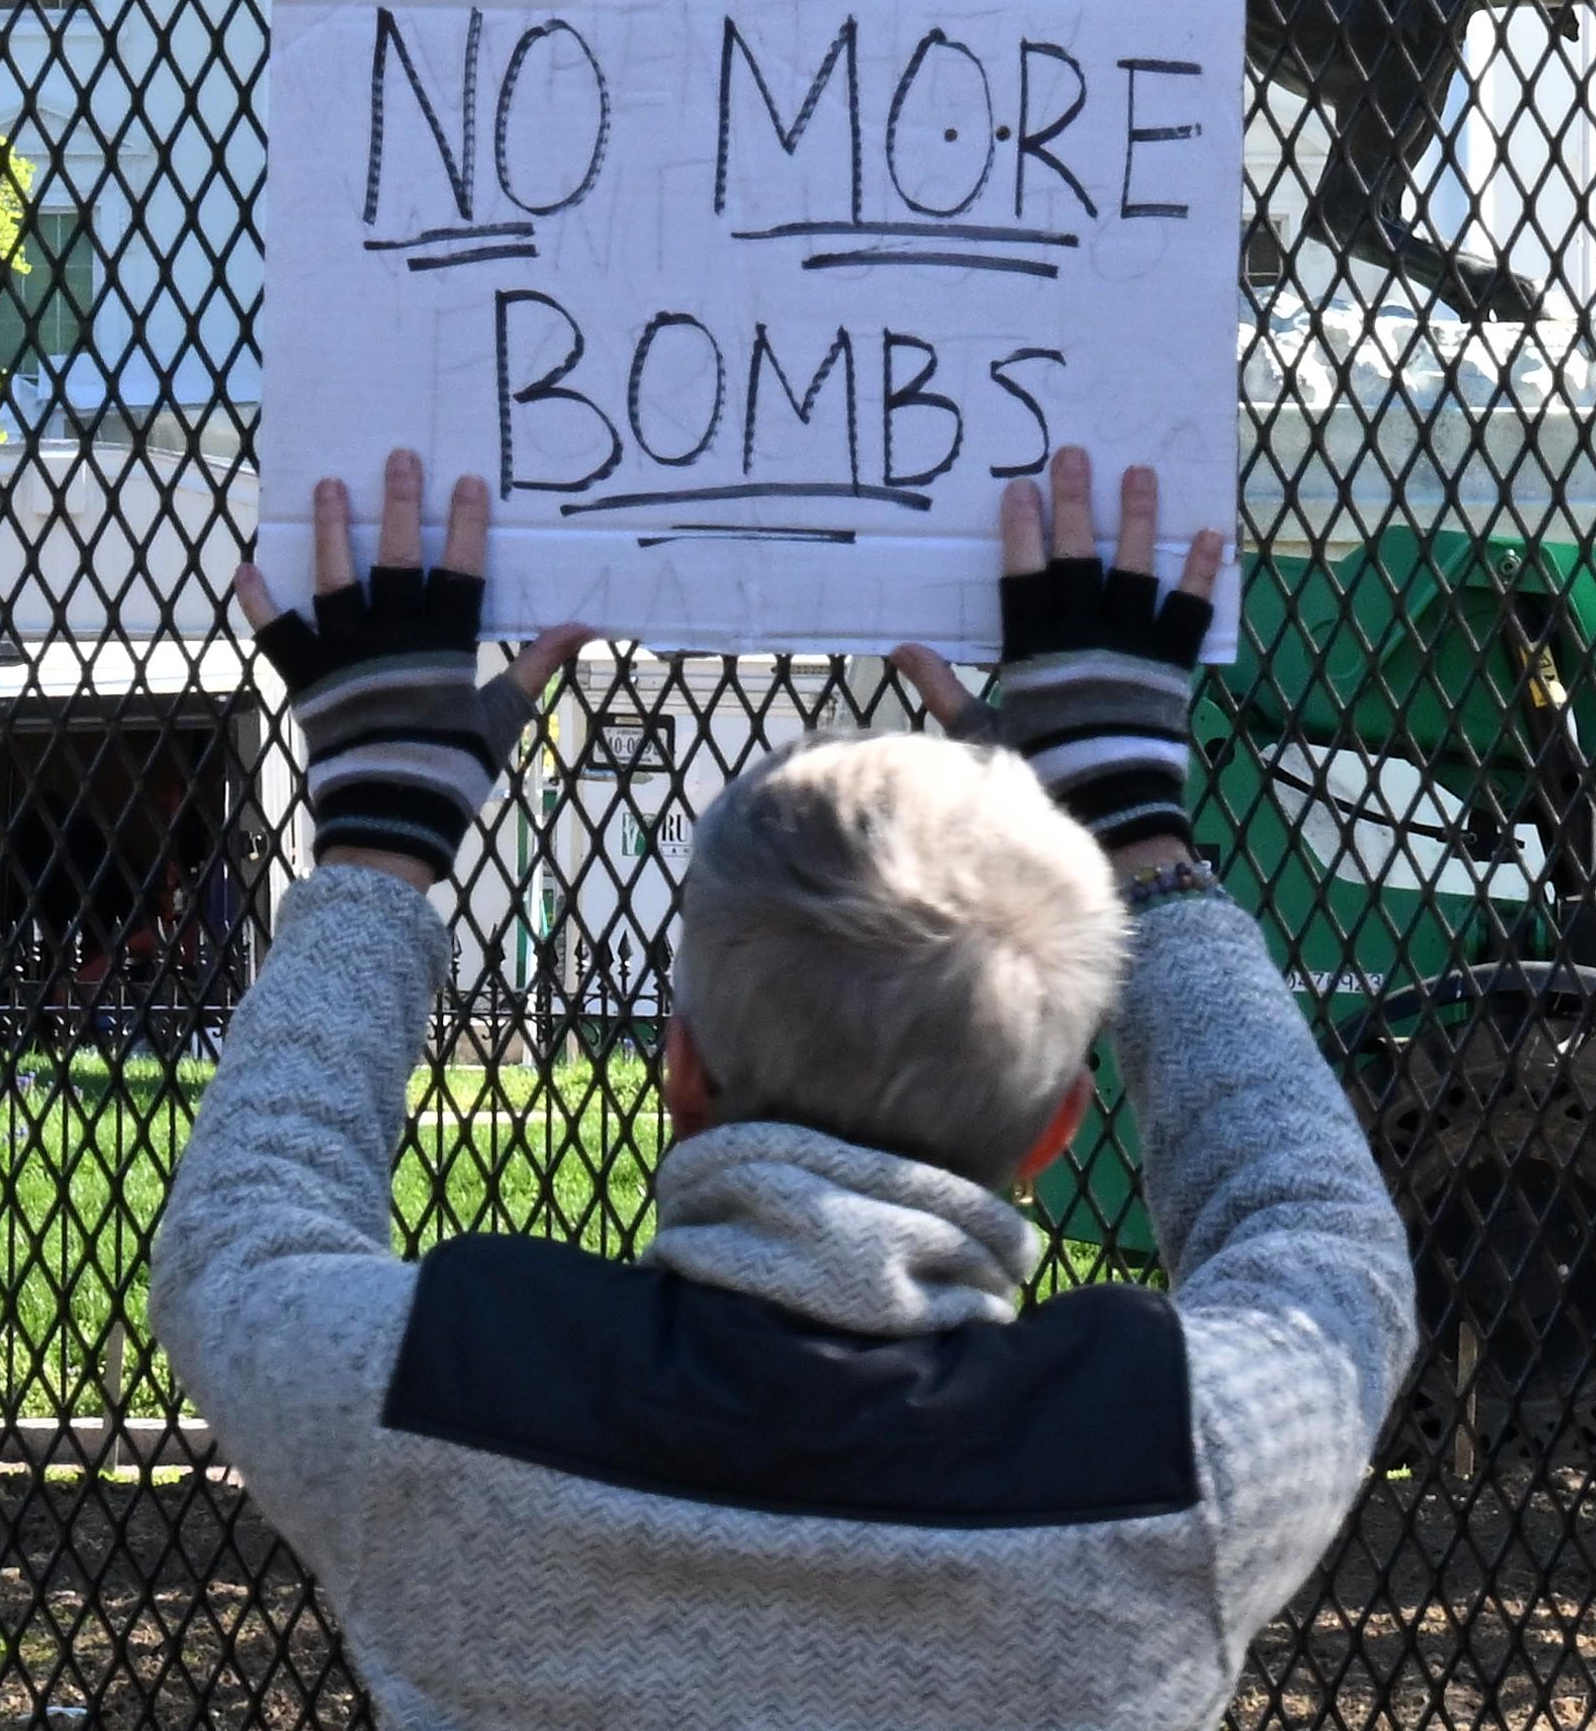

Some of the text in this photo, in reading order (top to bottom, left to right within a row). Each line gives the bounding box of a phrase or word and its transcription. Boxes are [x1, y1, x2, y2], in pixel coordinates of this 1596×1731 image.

[364, 5, 609, 224] NO
[715, 14, 1202, 224] MORE
[494, 287, 1066, 501] BOMBS
